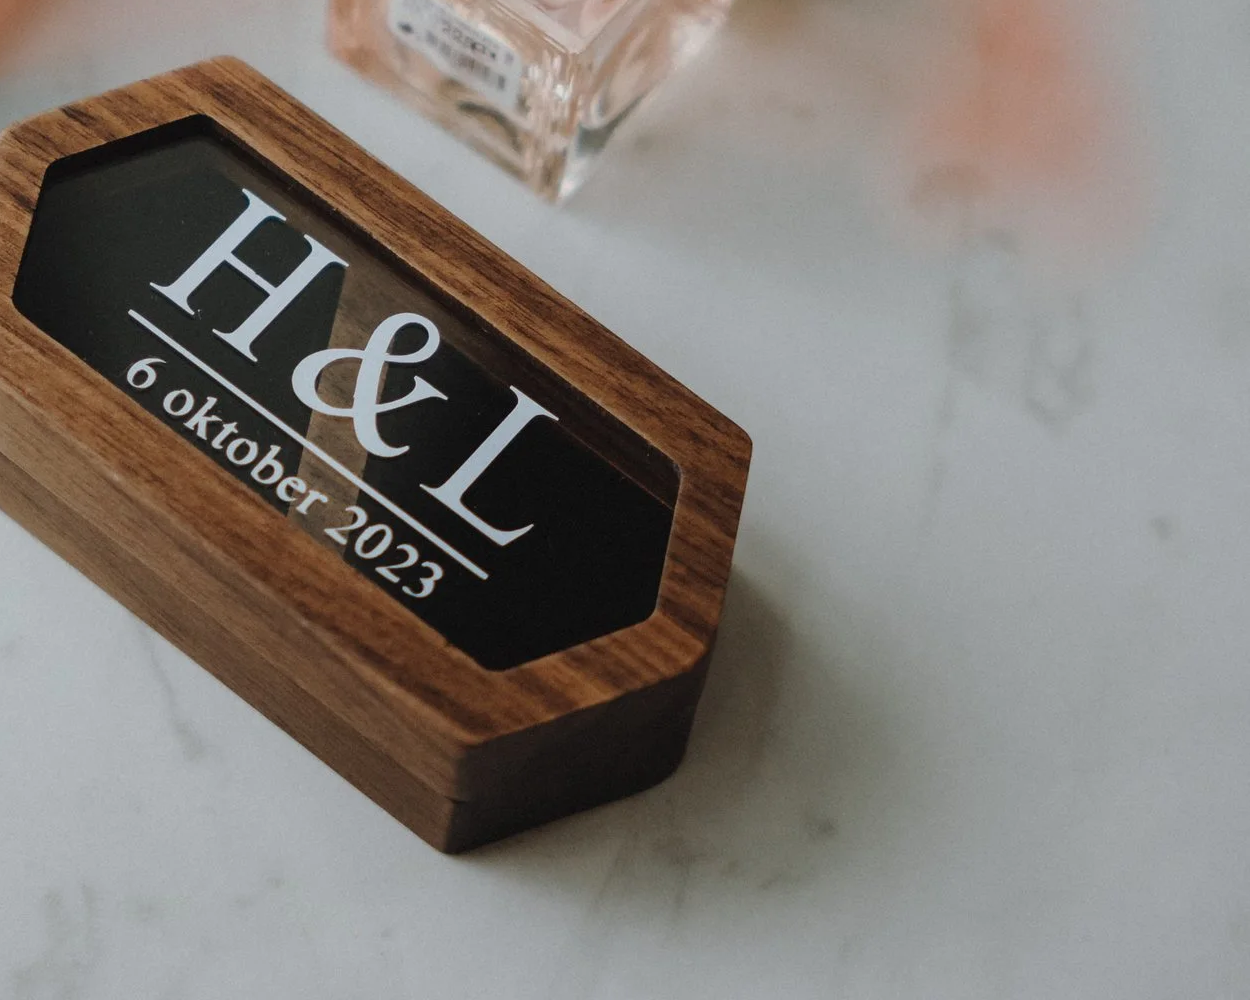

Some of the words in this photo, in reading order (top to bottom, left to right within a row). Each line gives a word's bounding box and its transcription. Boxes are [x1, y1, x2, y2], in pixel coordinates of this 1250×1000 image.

[126, 357, 167, 390] 6
[163, 389, 329, 517] oktober
[324, 505, 444, 600] 2023
[149, 188, 349, 362] H
[291, 312, 448, 458] &
[419, 385, 559, 547] L
